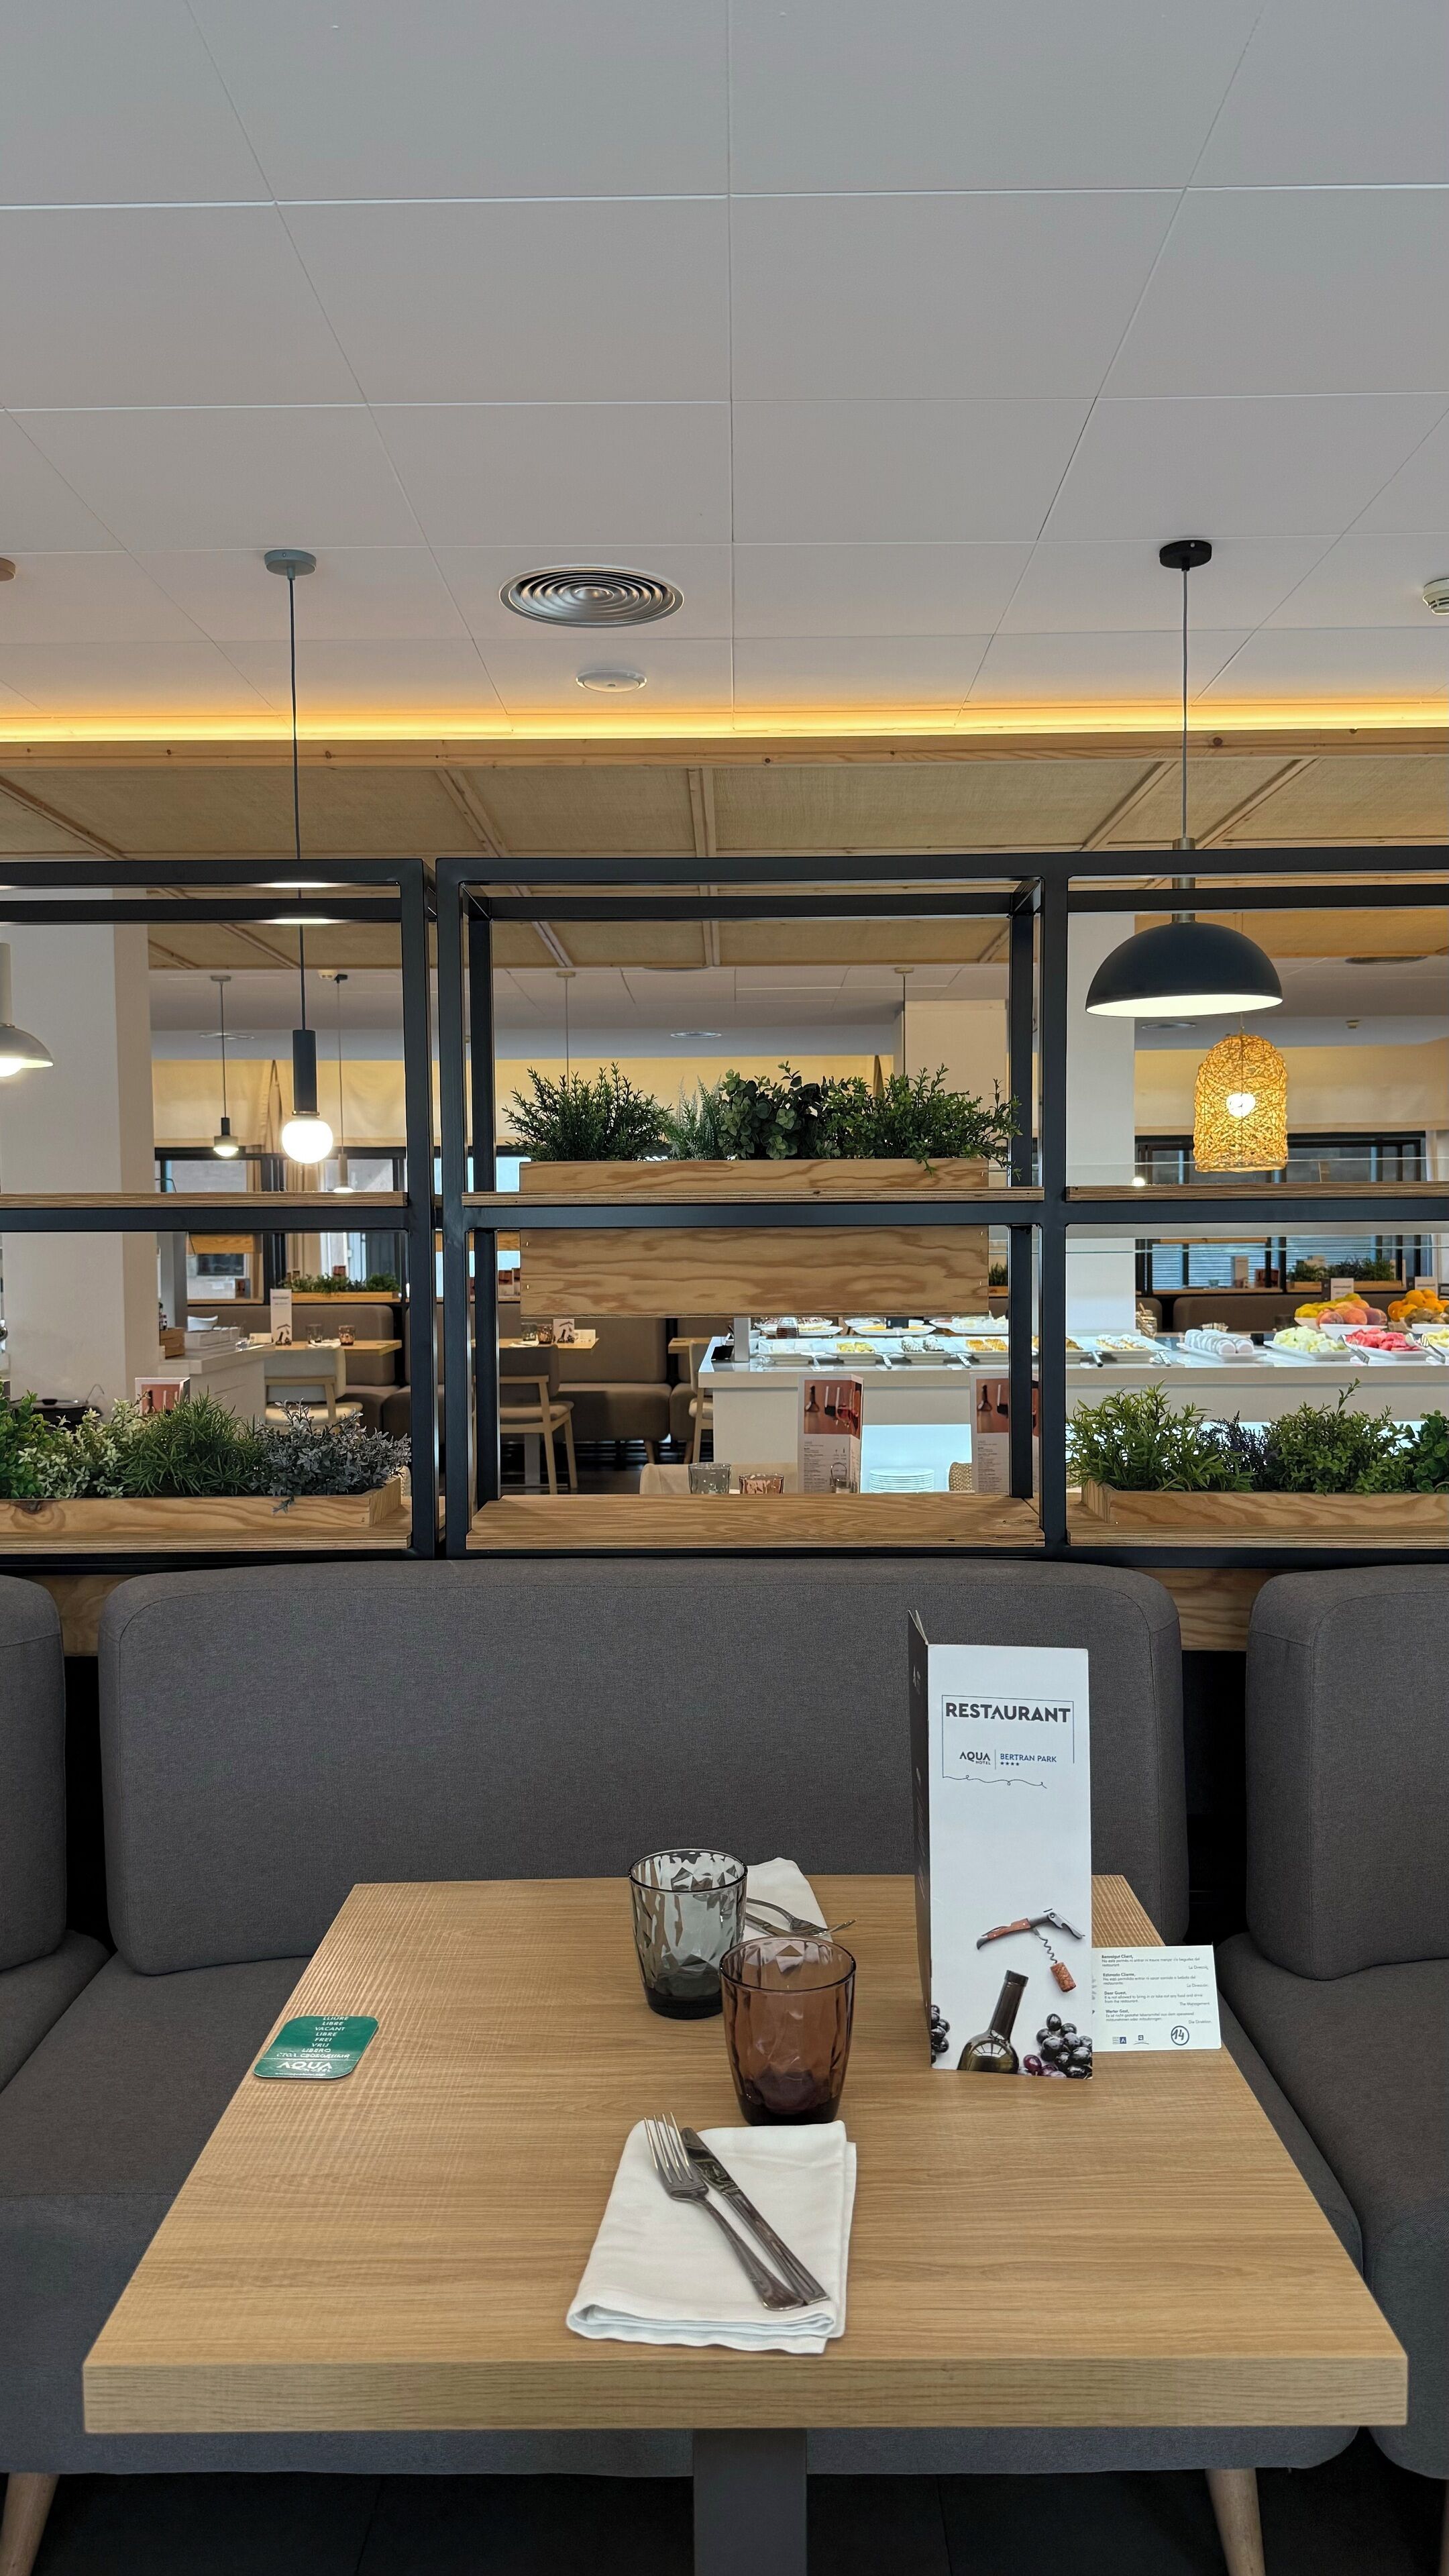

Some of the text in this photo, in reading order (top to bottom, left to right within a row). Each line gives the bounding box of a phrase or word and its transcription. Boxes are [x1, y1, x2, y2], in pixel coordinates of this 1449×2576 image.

[945, 1703, 1071, 1723] RESTAURANT
[959, 1751, 991, 1762] AQUA
[1000, 1754, 1035, 1762] BERTRAN
[1171, 2029, 1185, 2041] 14
[276, 2061, 333, 2070] AQUA
